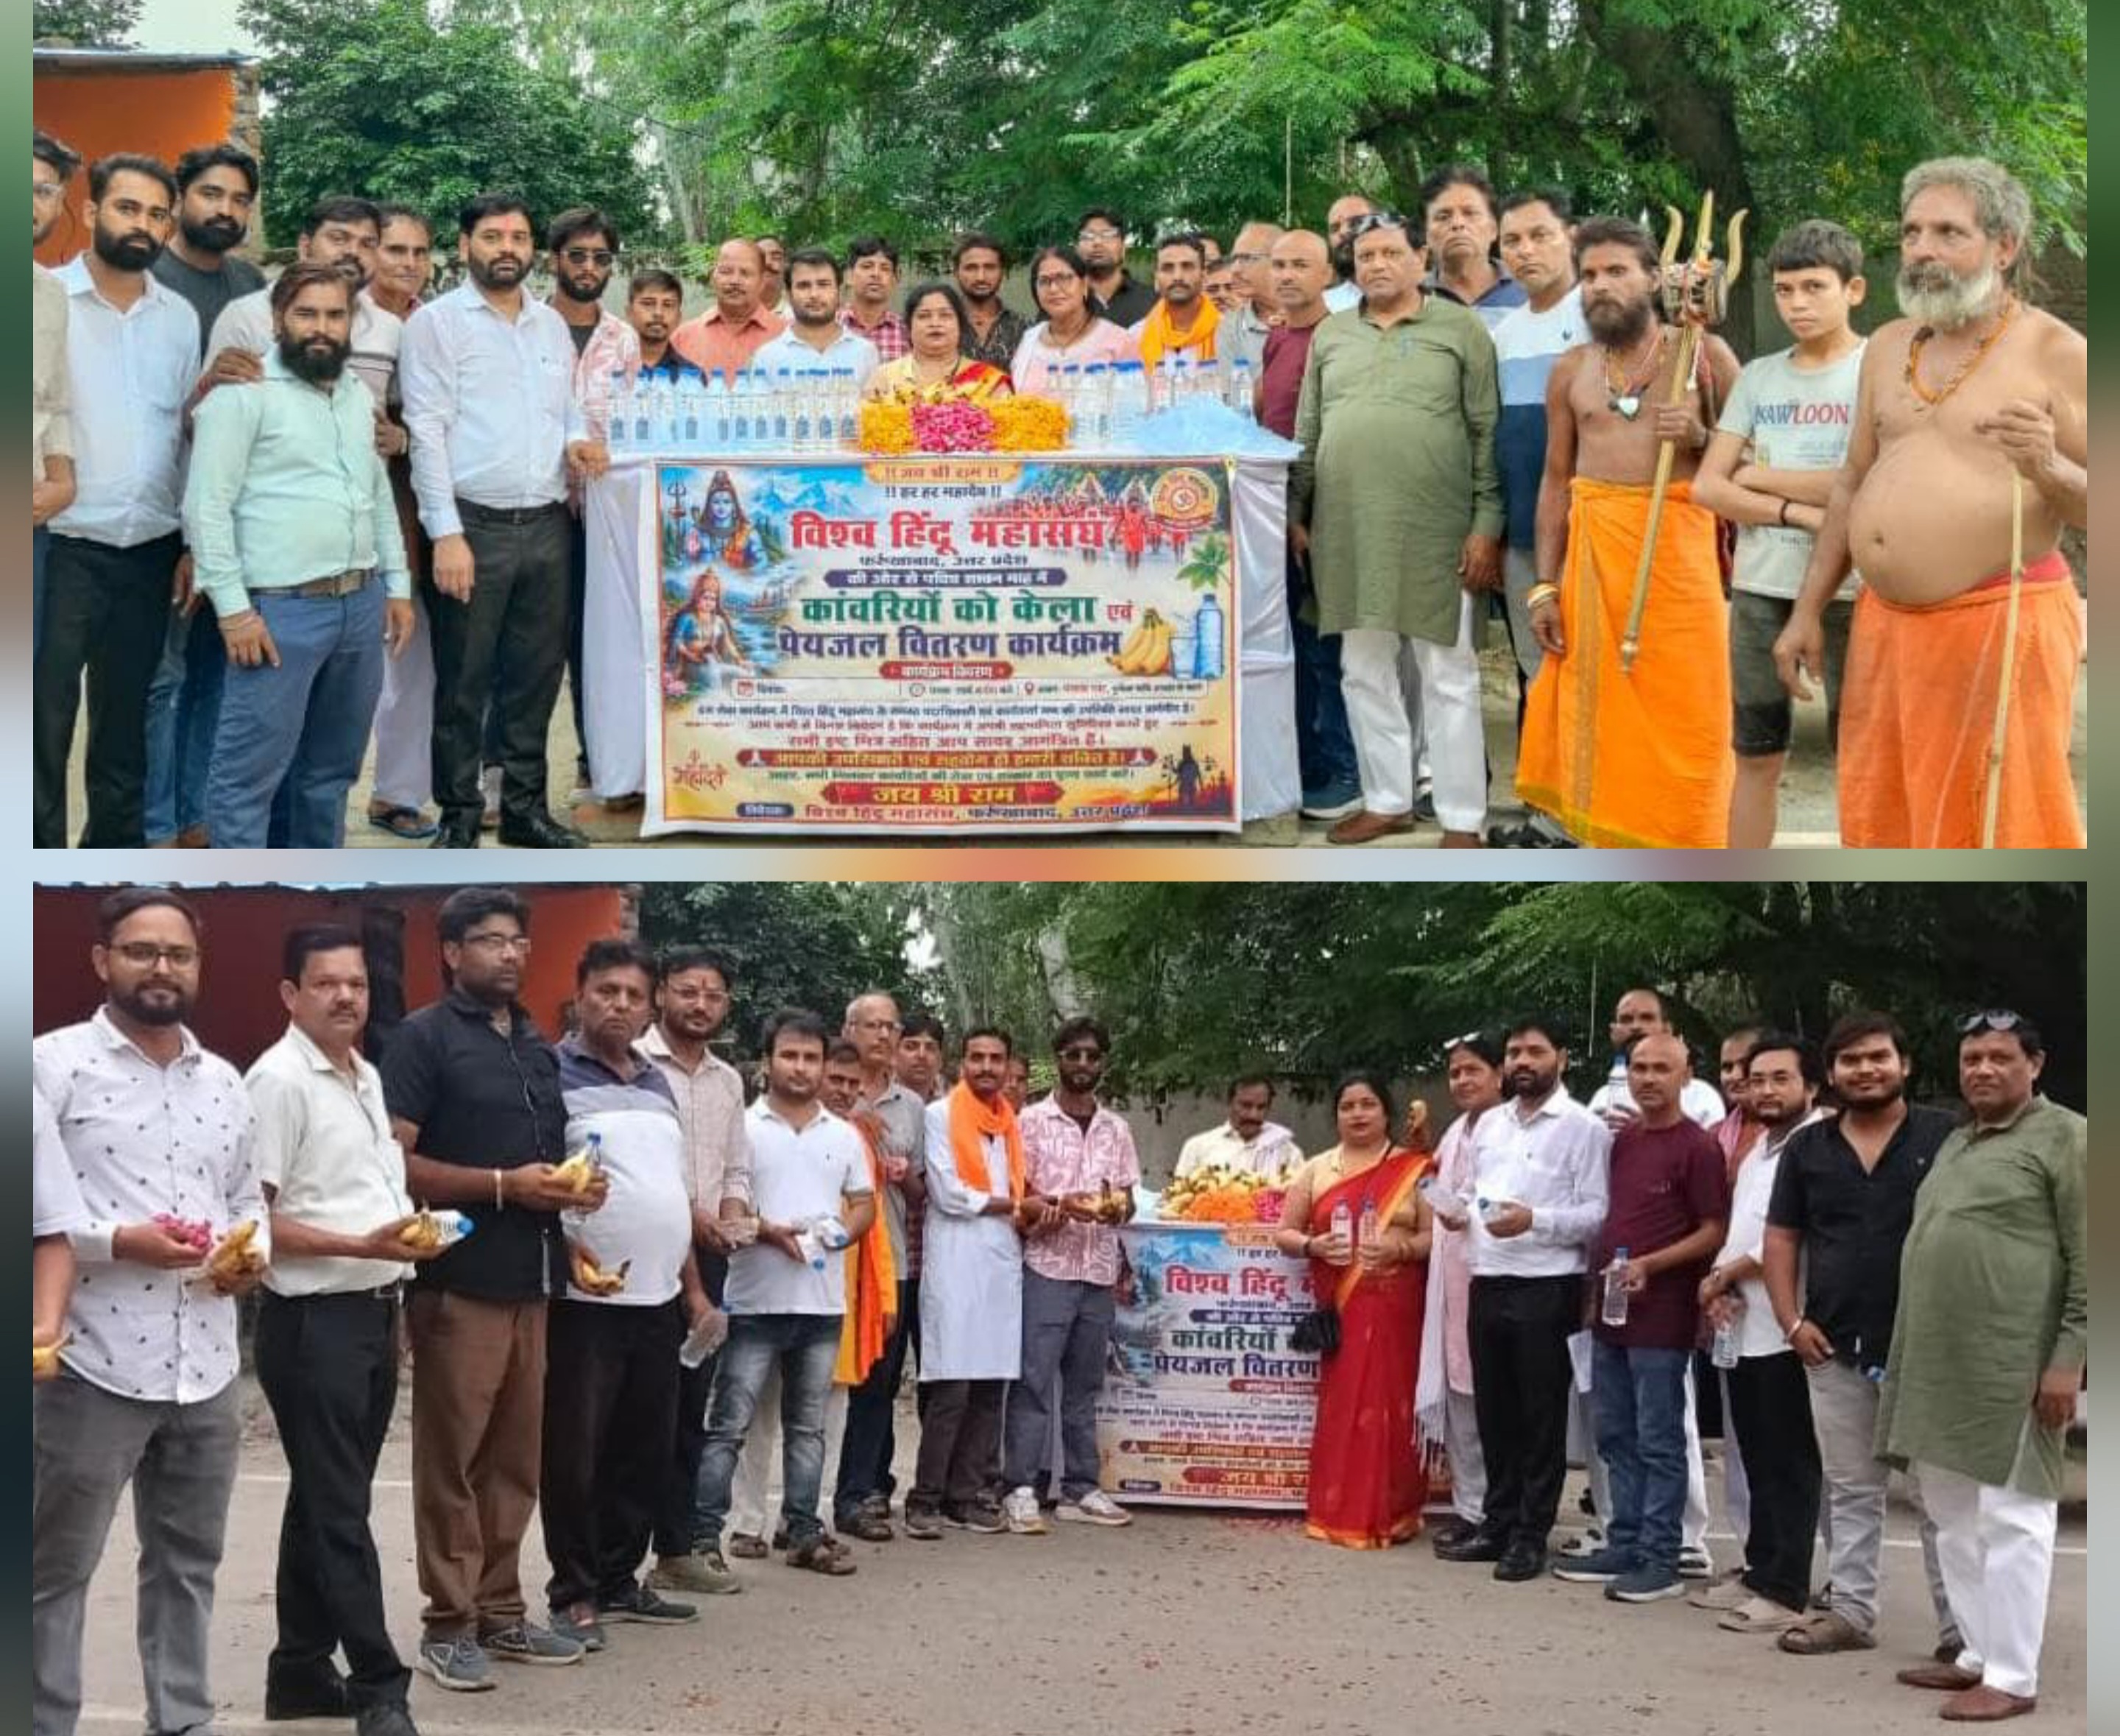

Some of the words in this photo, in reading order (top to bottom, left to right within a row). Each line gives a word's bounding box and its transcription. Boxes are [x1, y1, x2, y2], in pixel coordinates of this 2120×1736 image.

[930, 464, 950, 479] श्री
[955, 466, 981, 479] राम
[900, 486, 919, 498] हर
[922, 486, 939, 499] हर
[789, 510, 877, 549] विश्व
[890, 510, 958, 555] हिंदू
[970, 509, 1107, 549] महासंघ
[954, 556, 986, 566] उत्तर
[991, 553, 1028, 566] प्रदेश
[800, 590, 942, 624] कांवरियों
[952, 593, 999, 624] को
[1011, 592, 1098, 624] केला
[1106, 600, 1134, 622] एवं
[779, 626, 888, 657] पेयजल
[897, 625, 999, 657] वितरण
[1008, 624, 1124, 657] कार्यक्रम
[873, 787, 920, 803] जय
[928, 783, 955, 803] श्री
[968, 787, 1015, 802] राम
[1165, 1264, 1230, 1294] विश्व
[1240, 1265, 1290, 1302] हिंदू
[1170, 1325, 1278, 1351] कांवरियों
[1155, 1350, 1235, 1376] पेयजल
[1243, 1352, 1319, 1378] वितरण
